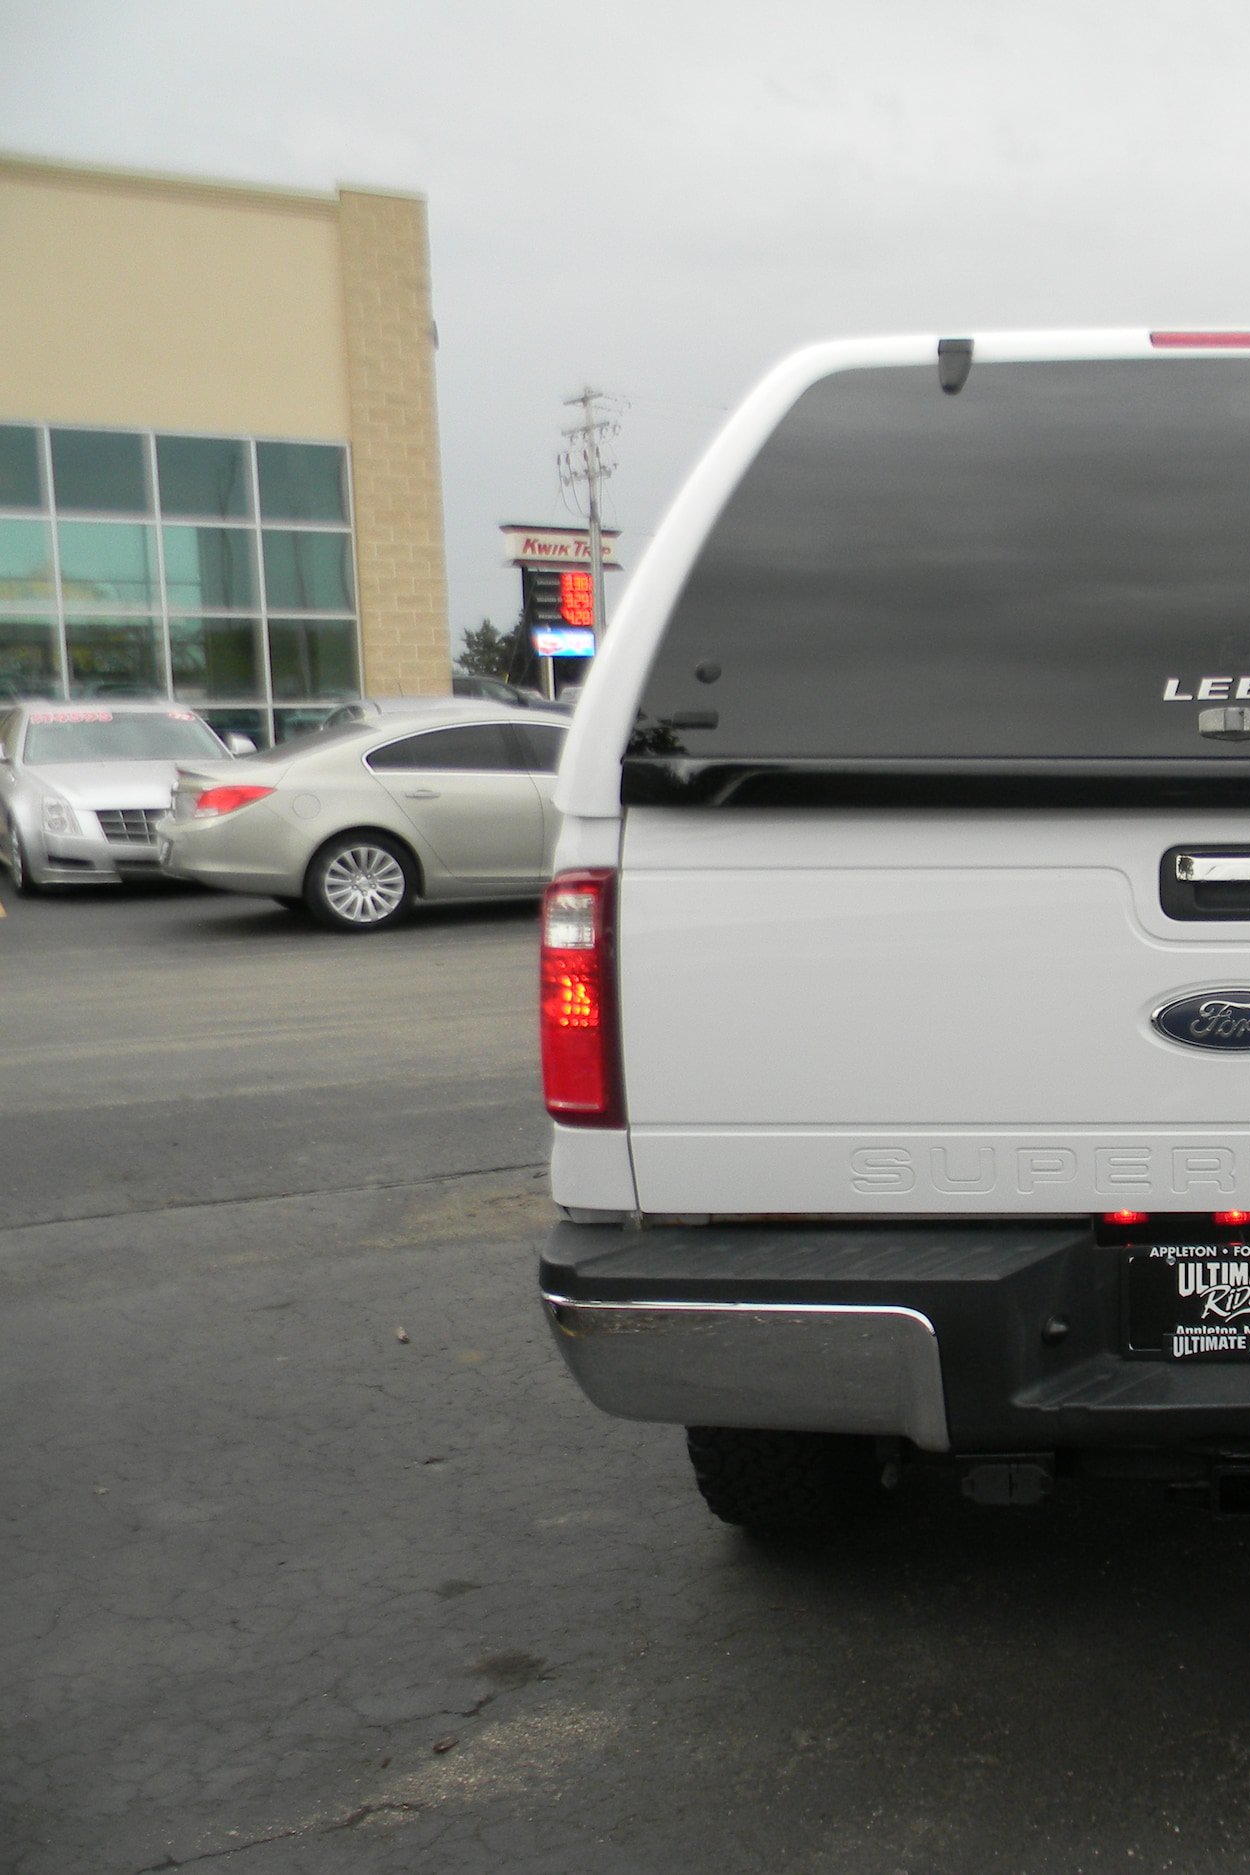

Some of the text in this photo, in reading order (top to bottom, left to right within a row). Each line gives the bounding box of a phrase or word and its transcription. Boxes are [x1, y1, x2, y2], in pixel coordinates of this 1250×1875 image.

[573, 540, 612, 557] TRP
[850, 1146, 1237, 1194] SUPER
[1150, 1246, 1217, 1258] APPLETON
[1172, 1335, 1247, 1358] ULTIMATE
